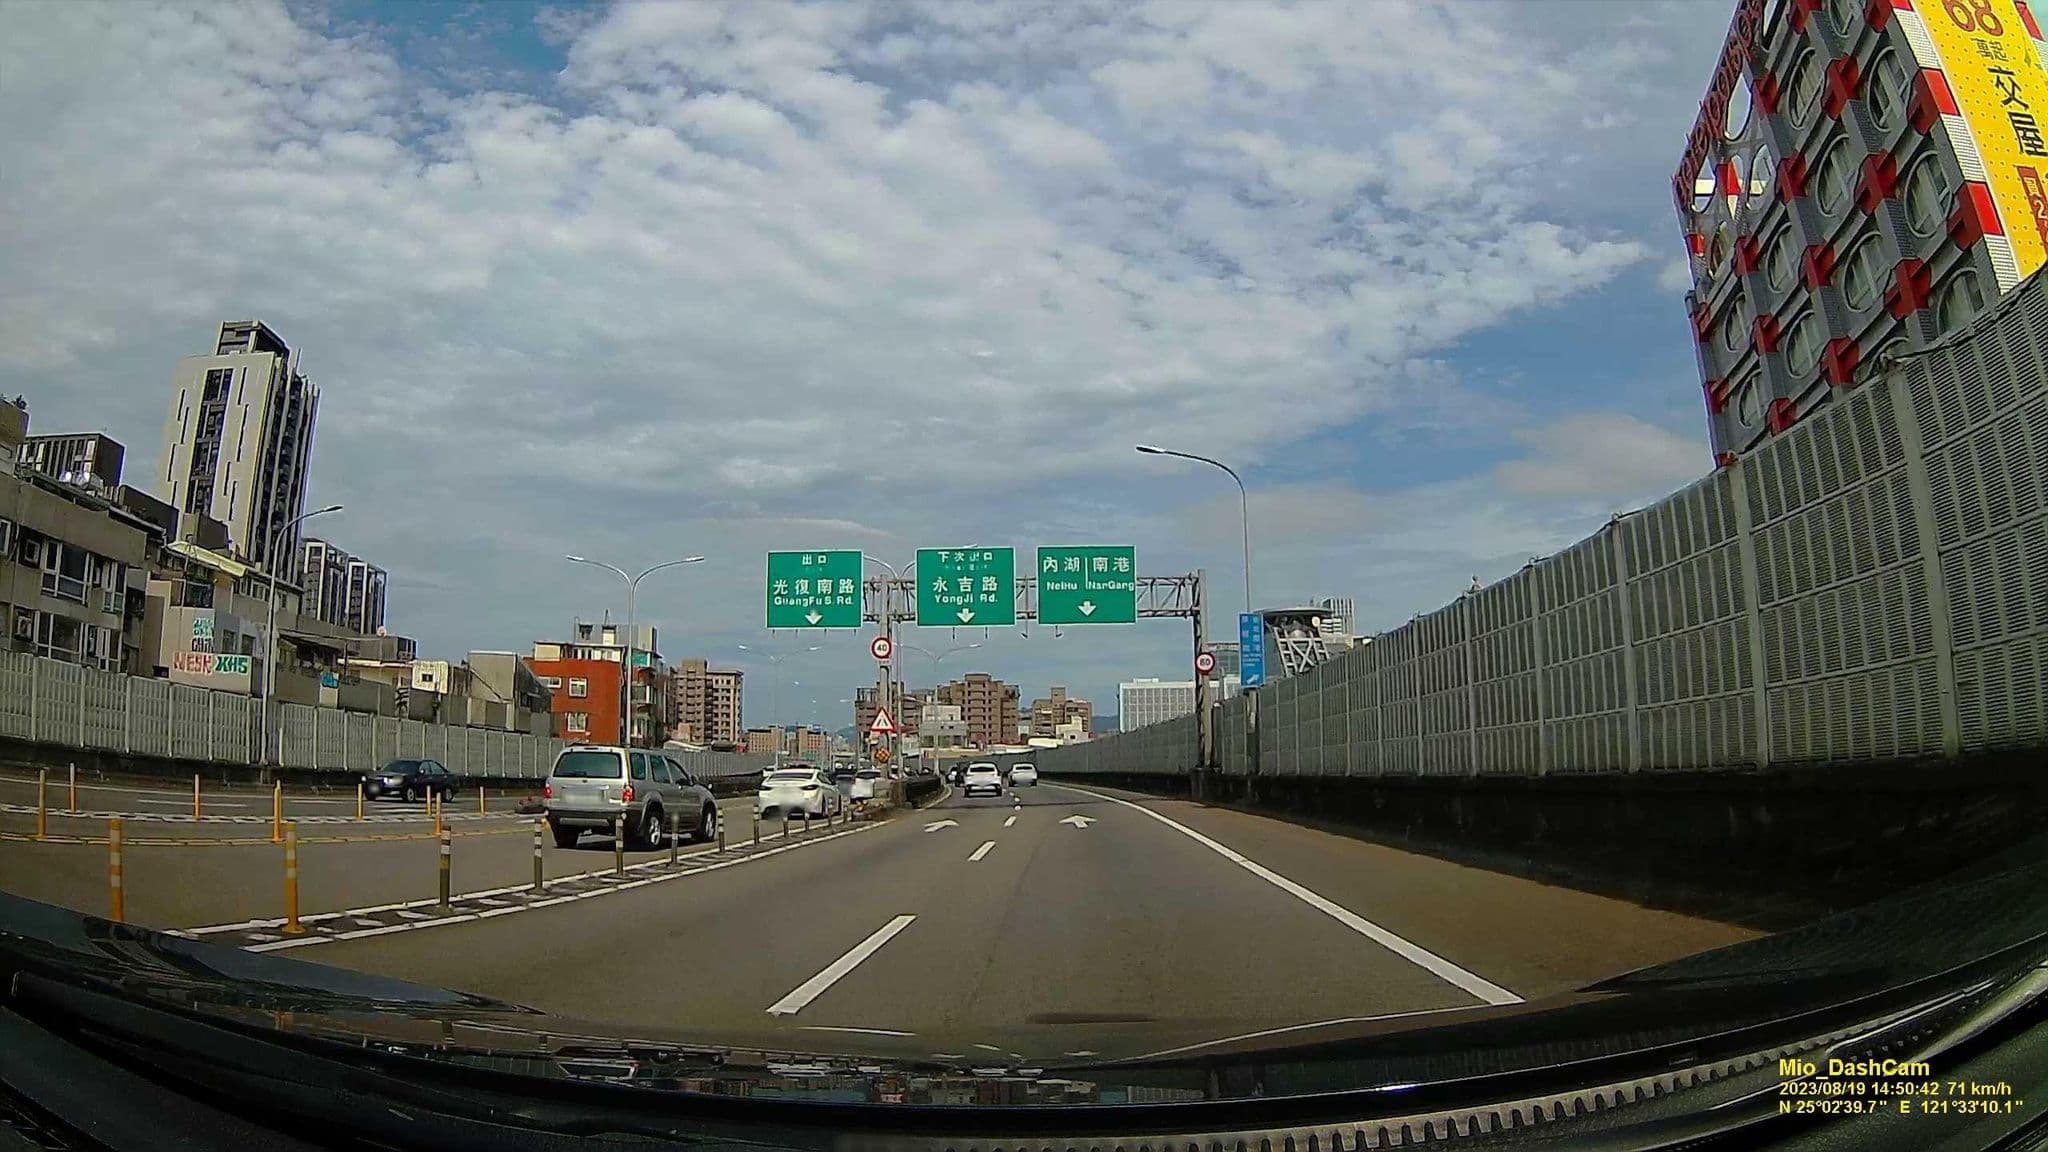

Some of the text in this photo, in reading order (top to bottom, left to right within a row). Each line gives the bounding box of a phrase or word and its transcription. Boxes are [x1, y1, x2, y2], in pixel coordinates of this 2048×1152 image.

[802, 553, 827, 565] 出口
[1043, 556, 1080, 573] 內湖
[1092, 556, 1130, 573] 南港
[773, 579, 855, 595] 光復南路
[932, 576, 998, 593] 永吉路
[877, 643, 888, 652] 40
